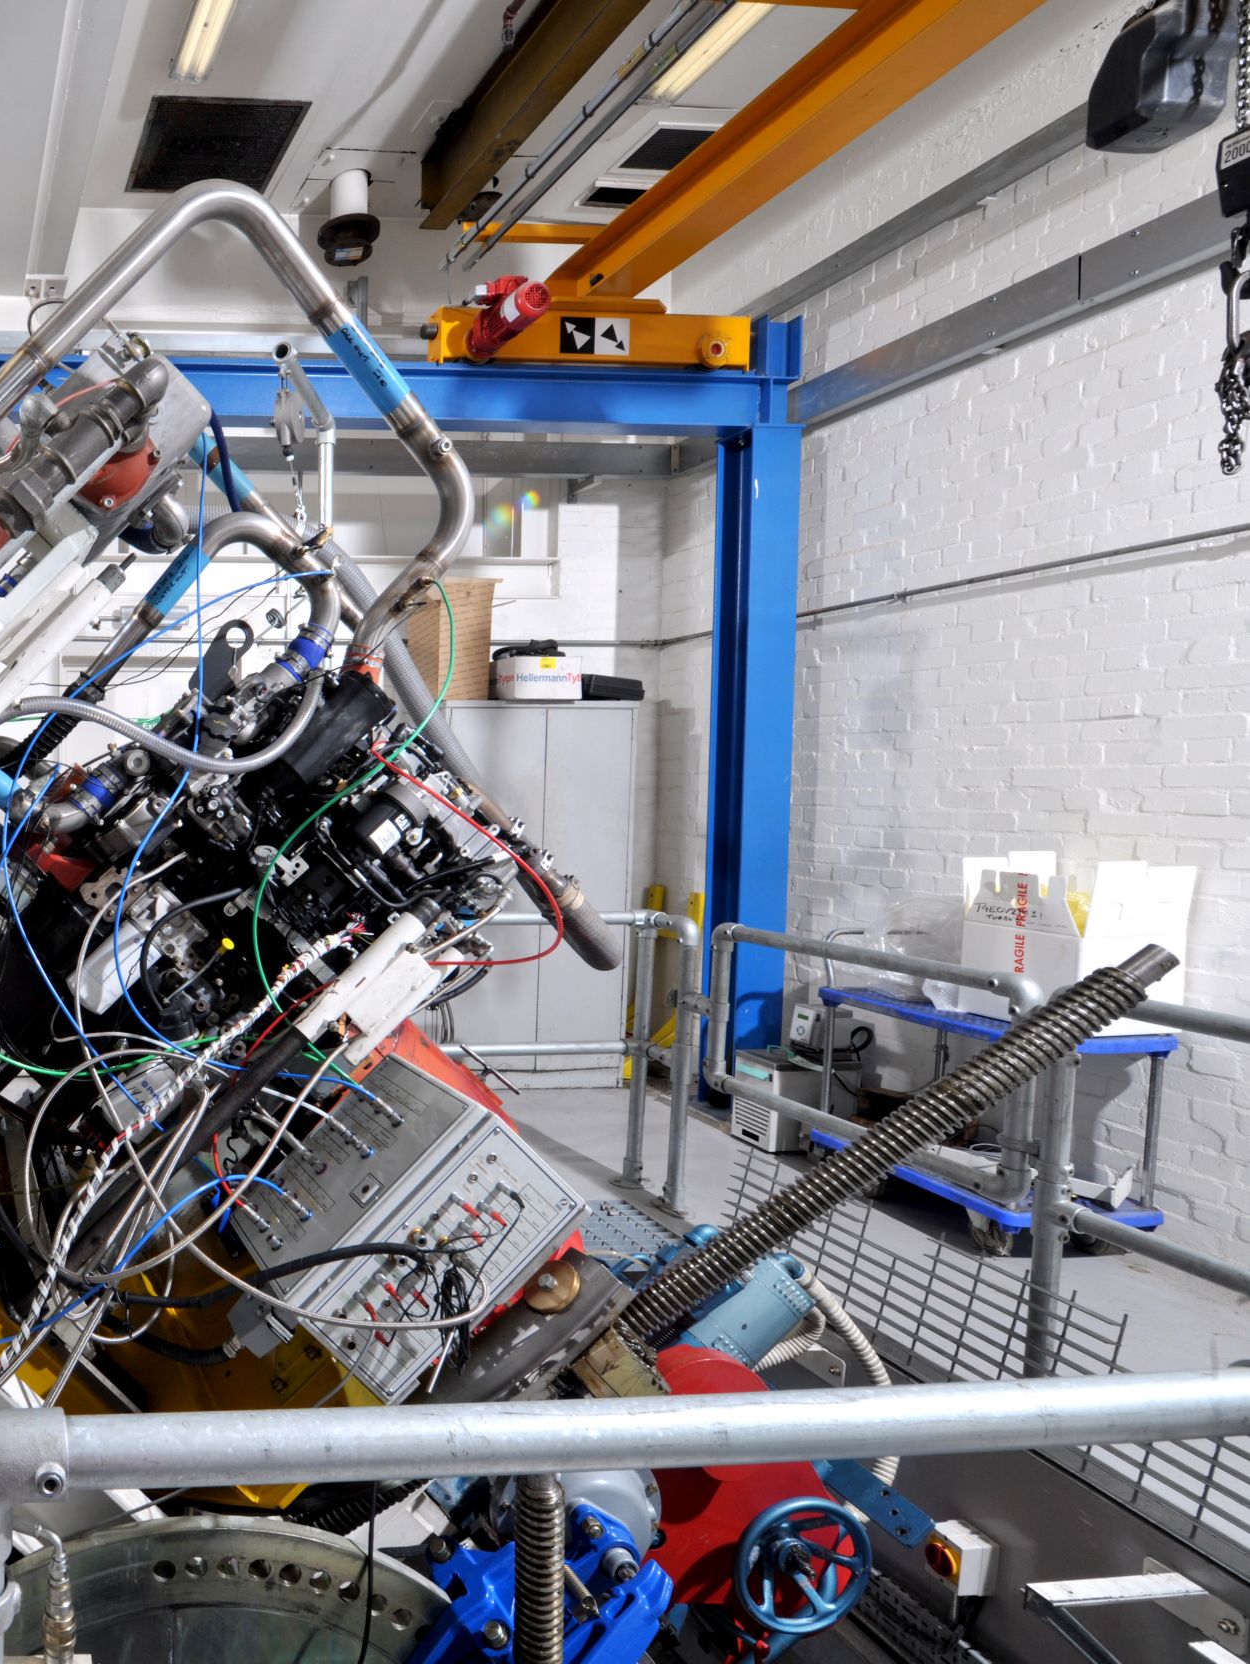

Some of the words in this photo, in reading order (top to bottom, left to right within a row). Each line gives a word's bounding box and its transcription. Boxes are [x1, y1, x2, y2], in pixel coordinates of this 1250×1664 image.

[516, 672, 581, 685] HellermannTyt
[395, 814, 411, 832] CAT
[1016, 883, 1028, 927] FRAGILE
[1014, 934, 1025, 974] RAGILE
